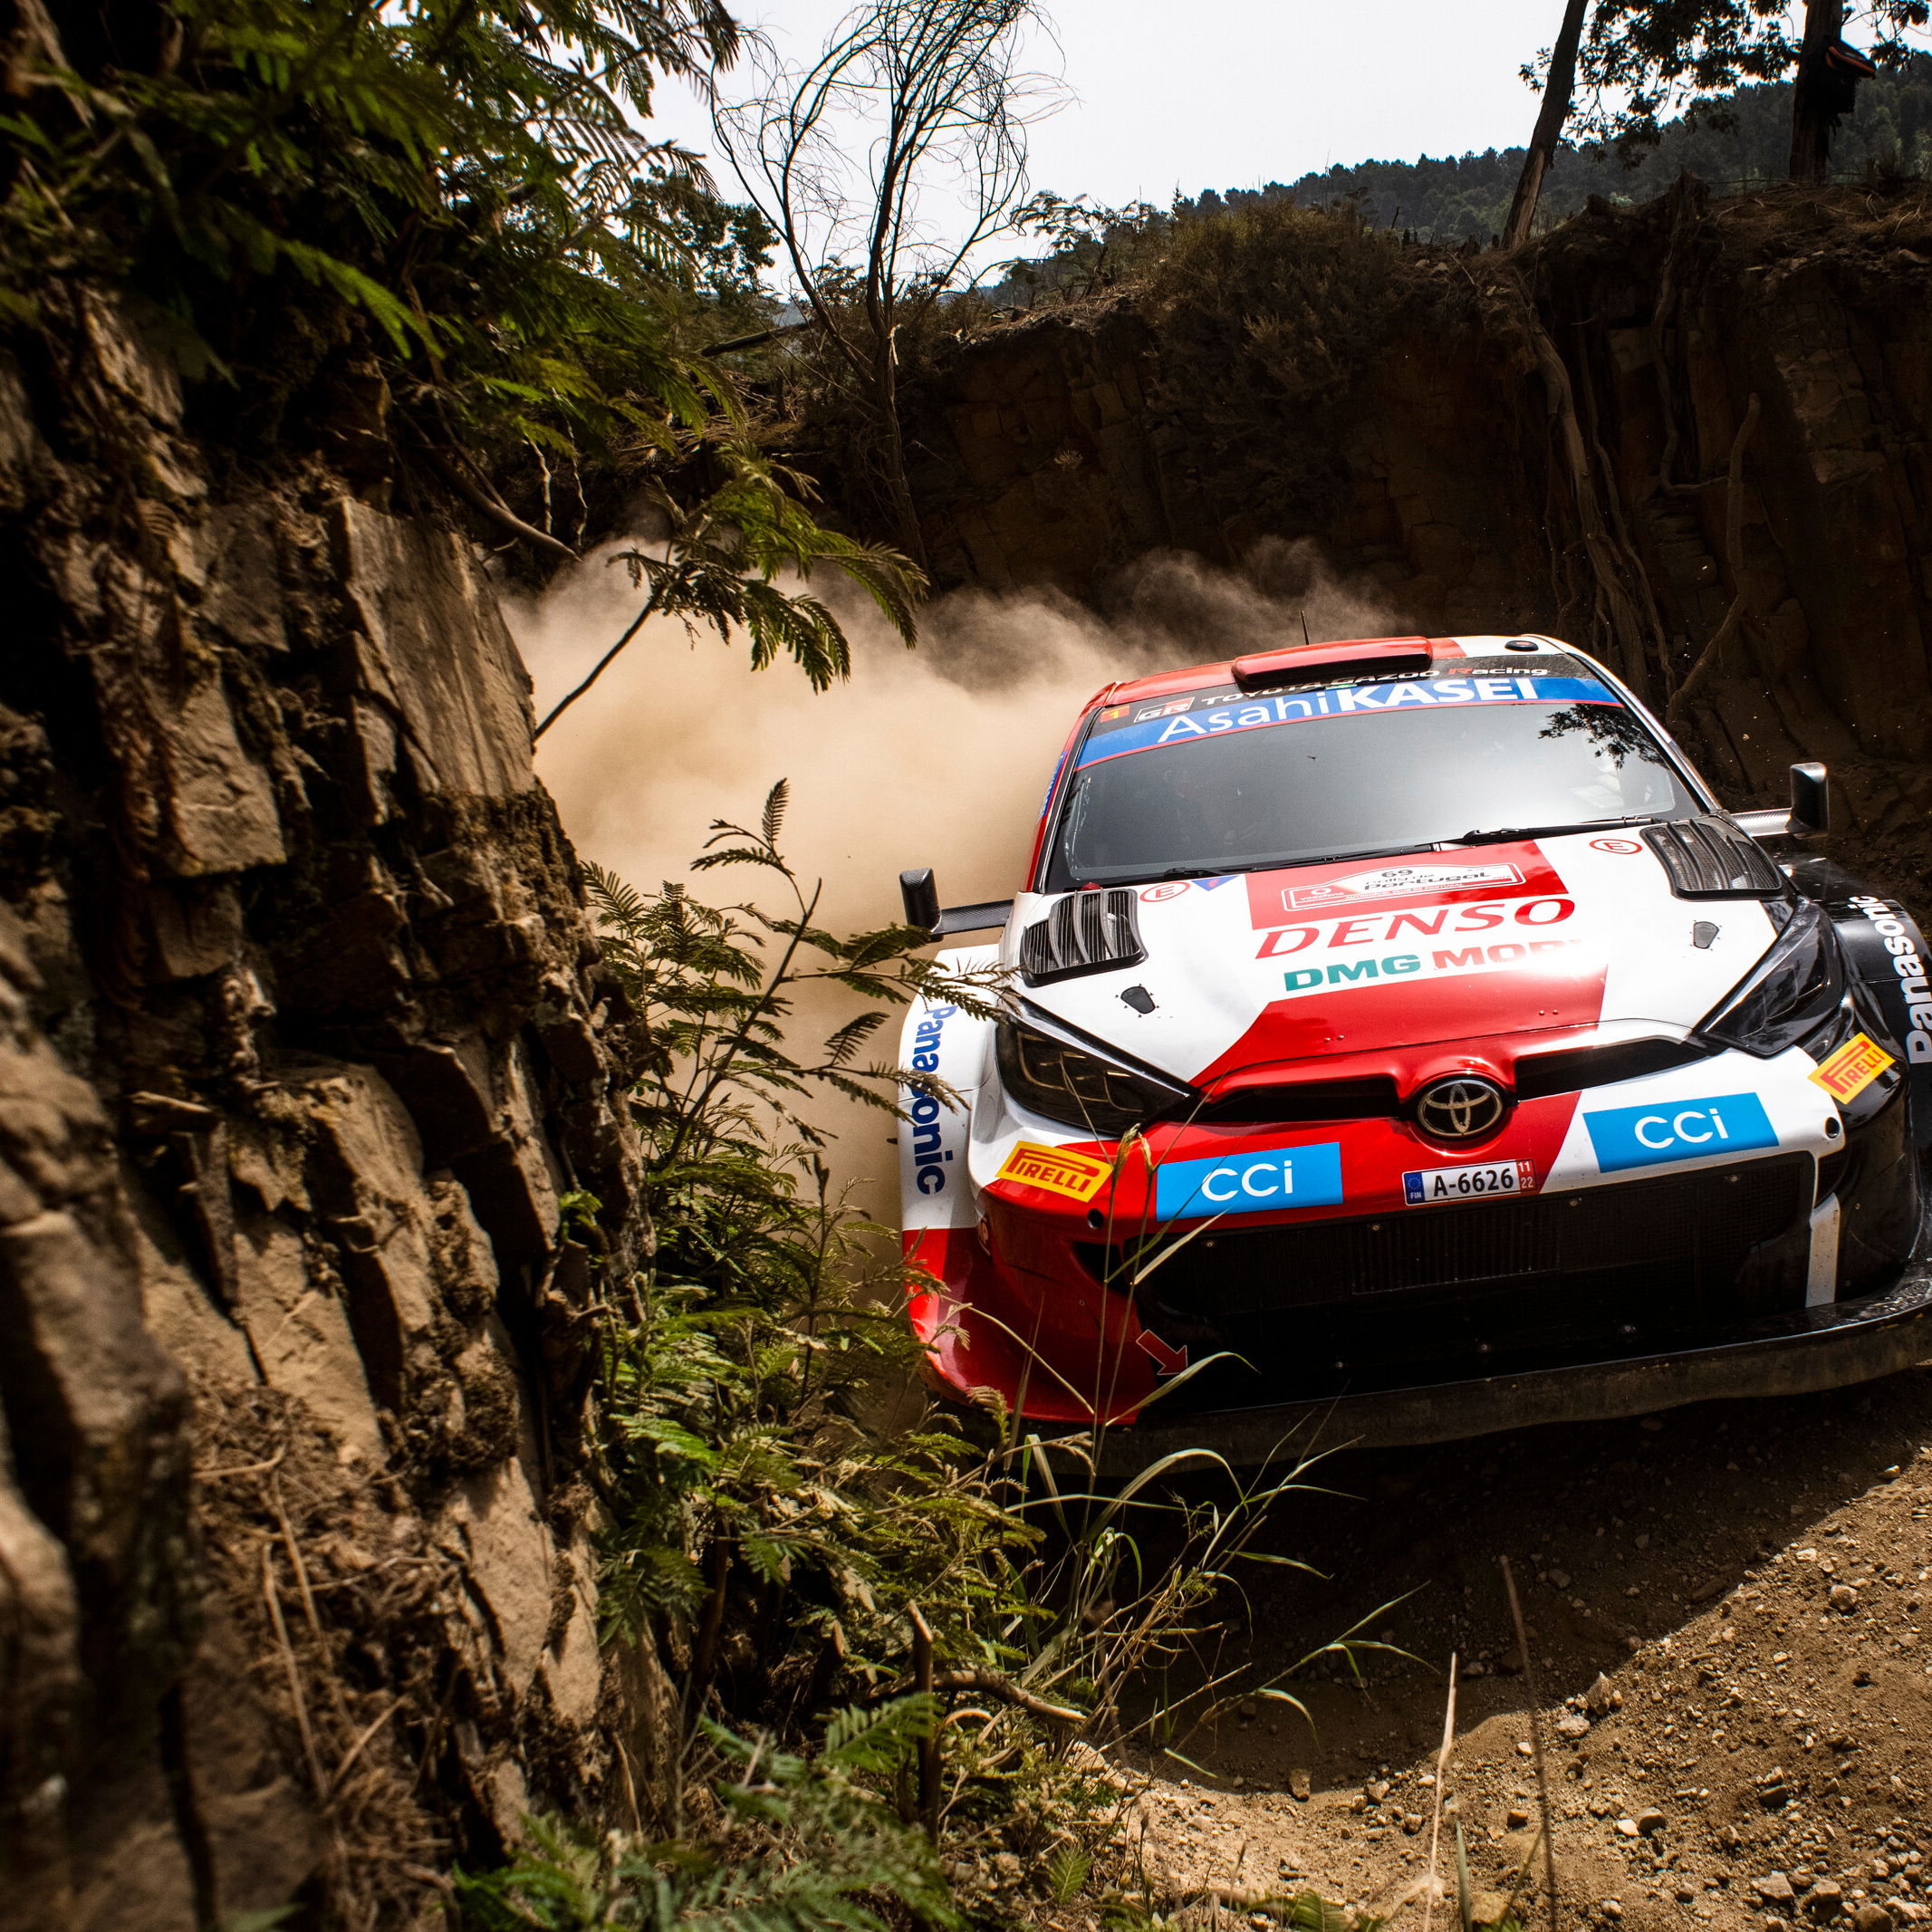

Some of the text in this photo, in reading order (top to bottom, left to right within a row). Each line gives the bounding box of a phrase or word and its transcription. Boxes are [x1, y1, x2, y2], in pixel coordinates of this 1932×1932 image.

[1448, 667, 1548, 676] Racing
[1381, 869, 1414, 878] 69
[1254, 898, 1576, 960] DENSO
[1283, 954, 1421, 992] DMG
[1819, 1040, 1885, 1096] PIRELLI
[1004, 1147, 1101, 1193] PIRELLI
[1409, 1167, 1514, 1200] FIN A-6626
[1517, 1161, 1532, 1173] 11
[1521, 1176, 1533, 1188] 22
